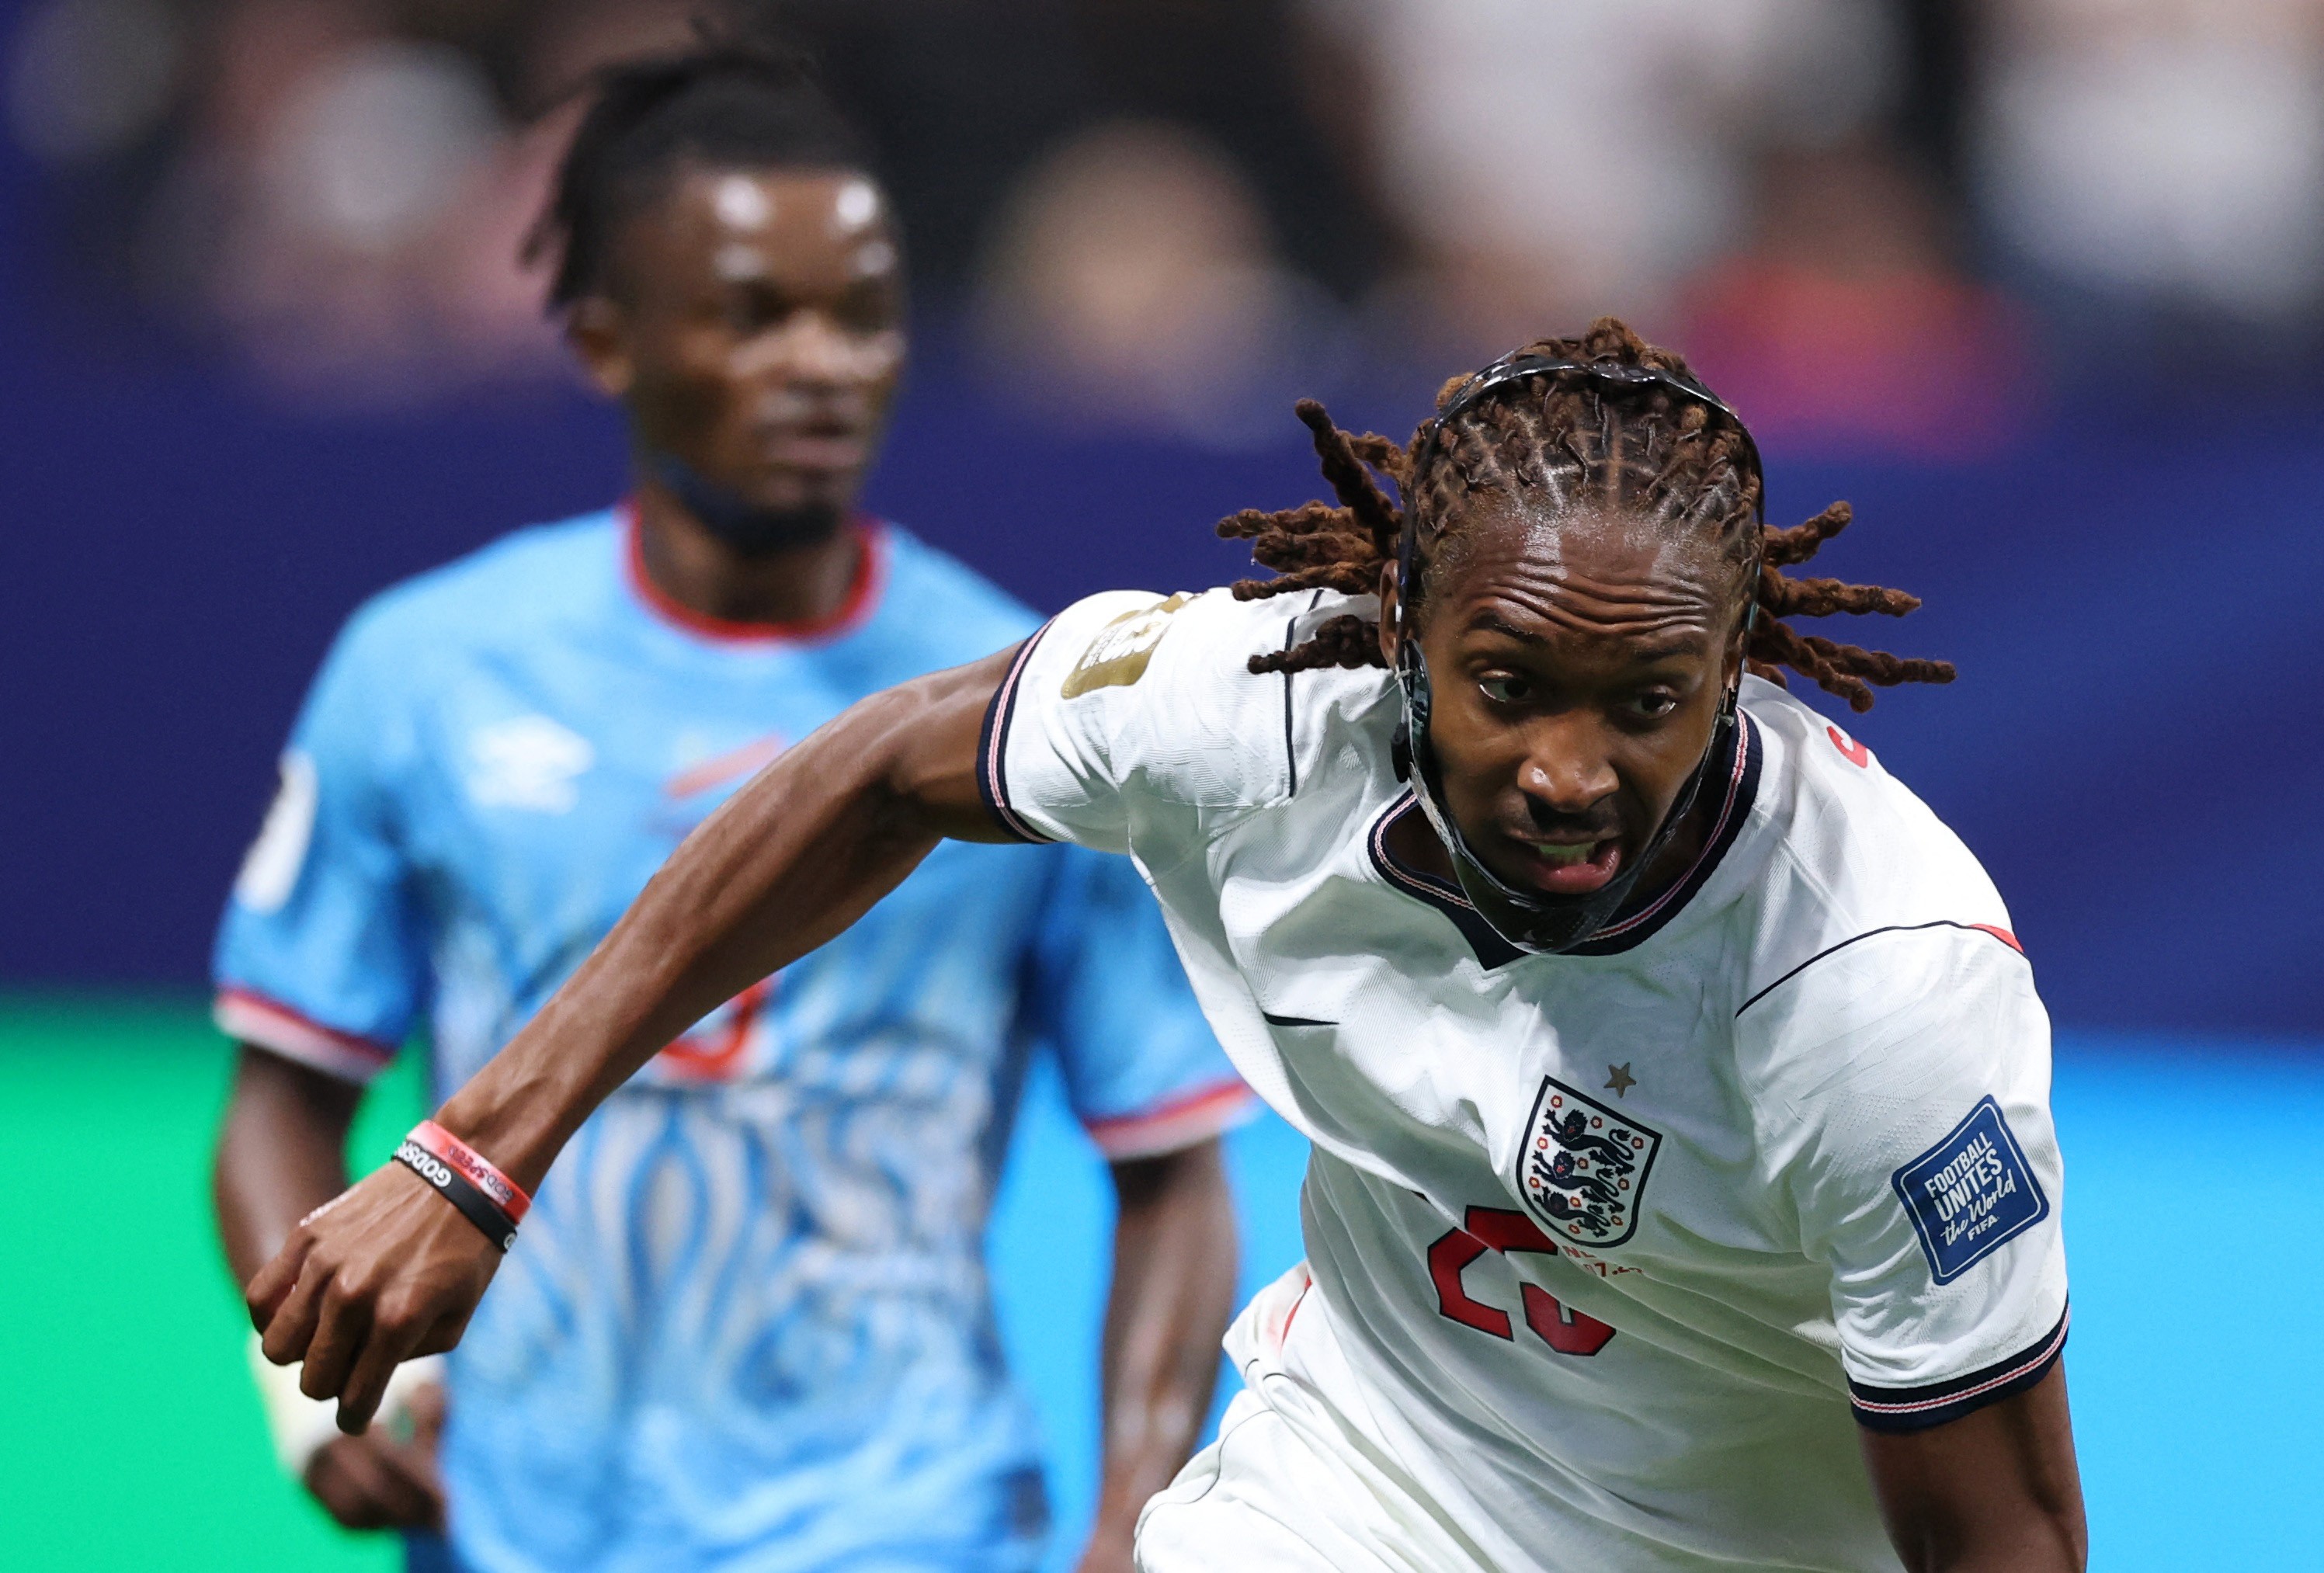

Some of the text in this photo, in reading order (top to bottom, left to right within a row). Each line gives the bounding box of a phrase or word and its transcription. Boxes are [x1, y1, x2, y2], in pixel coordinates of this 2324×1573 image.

[1924, 1131, 1993, 1198] FOOTBALL
[1933, 1148, 2003, 1222] UNITES
[1940, 1168, 2017, 1246] the World
[1966, 1214, 1999, 1241] FIFA
